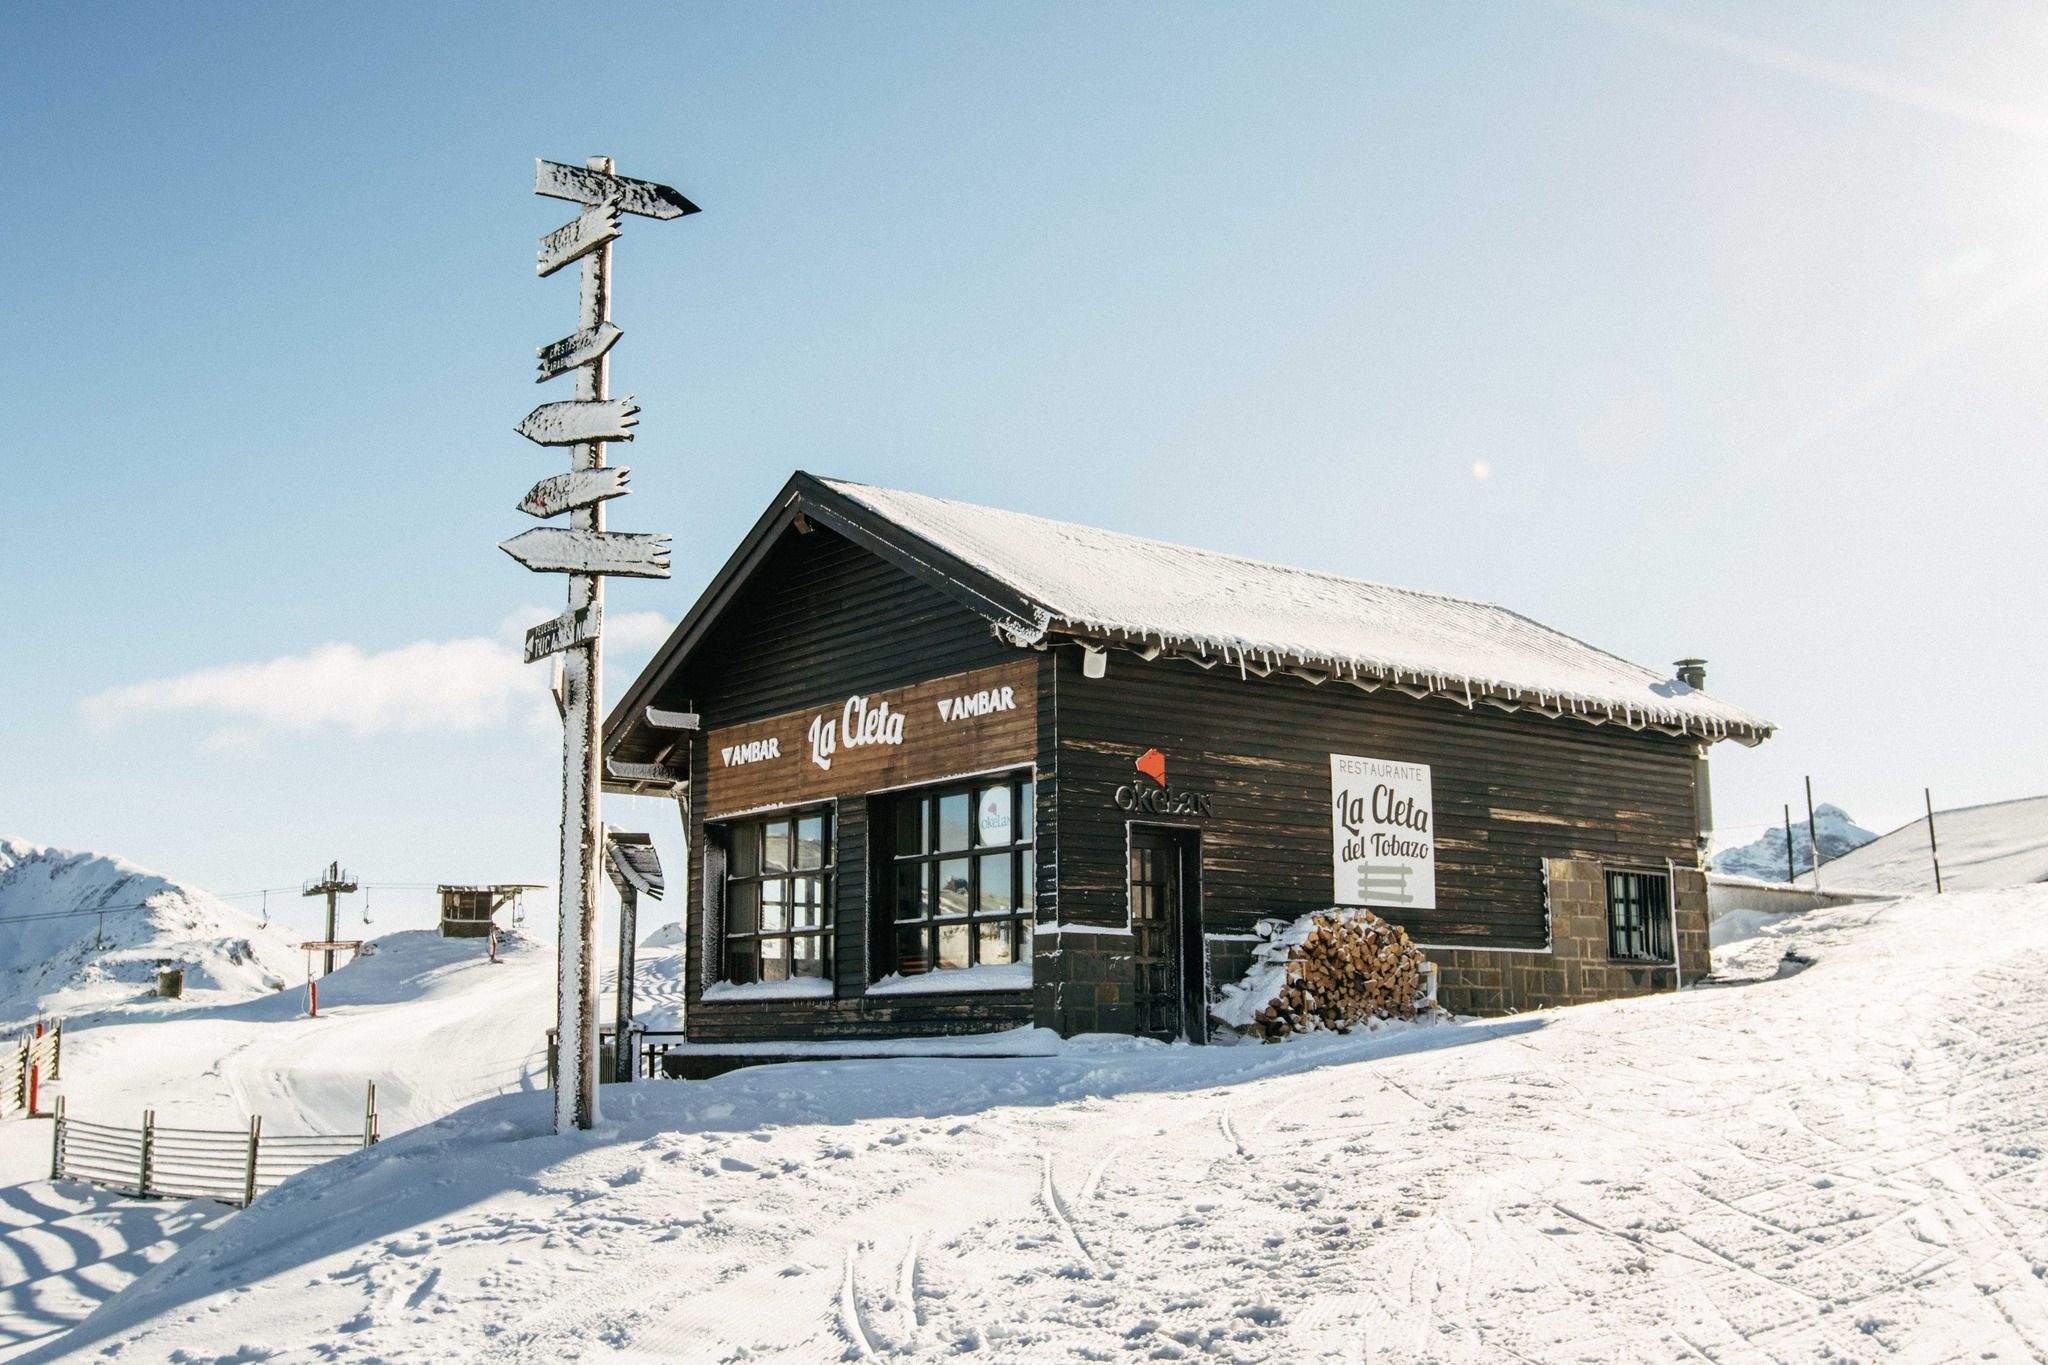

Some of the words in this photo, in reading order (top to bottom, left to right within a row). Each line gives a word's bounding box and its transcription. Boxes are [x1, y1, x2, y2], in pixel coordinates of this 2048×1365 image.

[808, 714, 837, 771] La
[842, 695, 906, 748] Cleta
[1339, 759, 1423, 782] RESTAURANTE
[1336, 789, 1365, 837] La
[1372, 784, 1429, 833] Cleta
[1342, 836, 1366, 863] del
[1370, 832, 1429, 859] Tobazo
